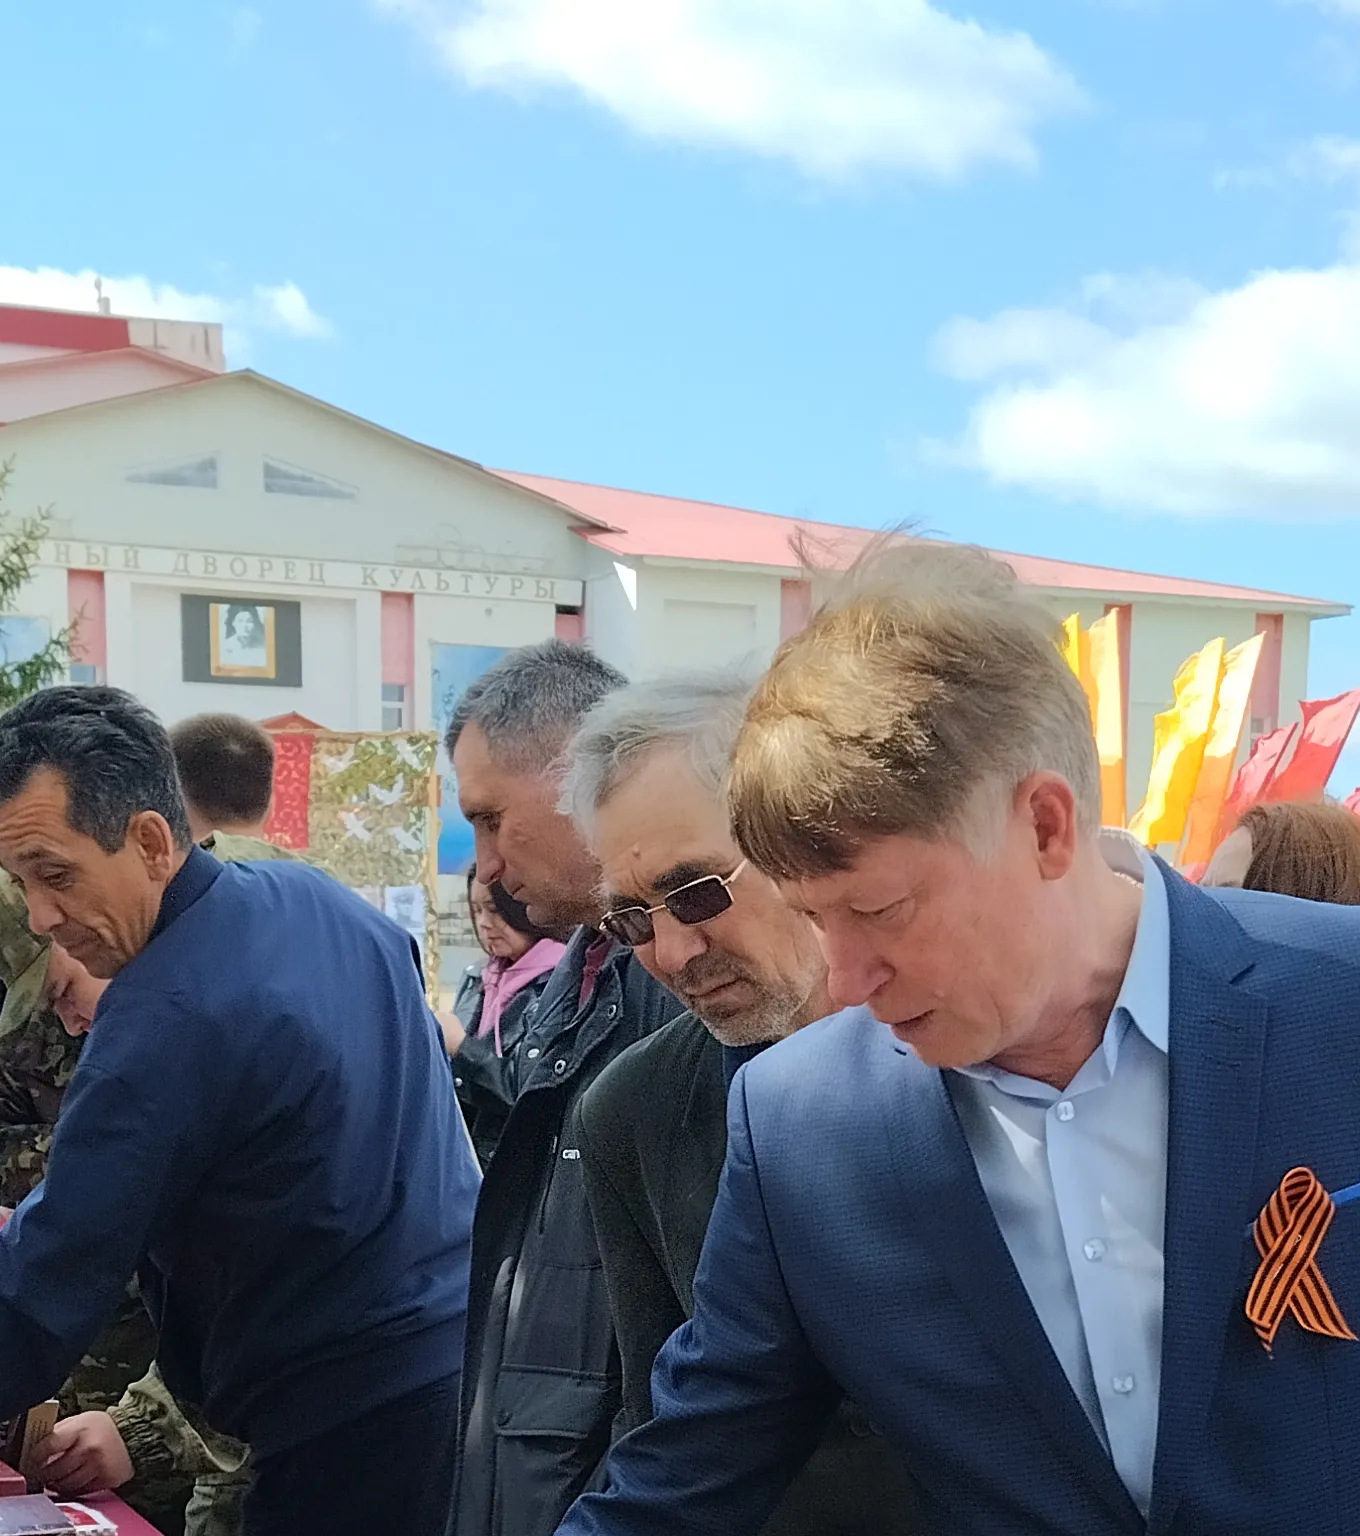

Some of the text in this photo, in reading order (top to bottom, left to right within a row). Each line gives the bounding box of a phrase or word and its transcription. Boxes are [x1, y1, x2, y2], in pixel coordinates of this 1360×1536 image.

[53, 541, 557, 600] НЫЙ ДВОРЕЦ КУЛЬТУРЫ
